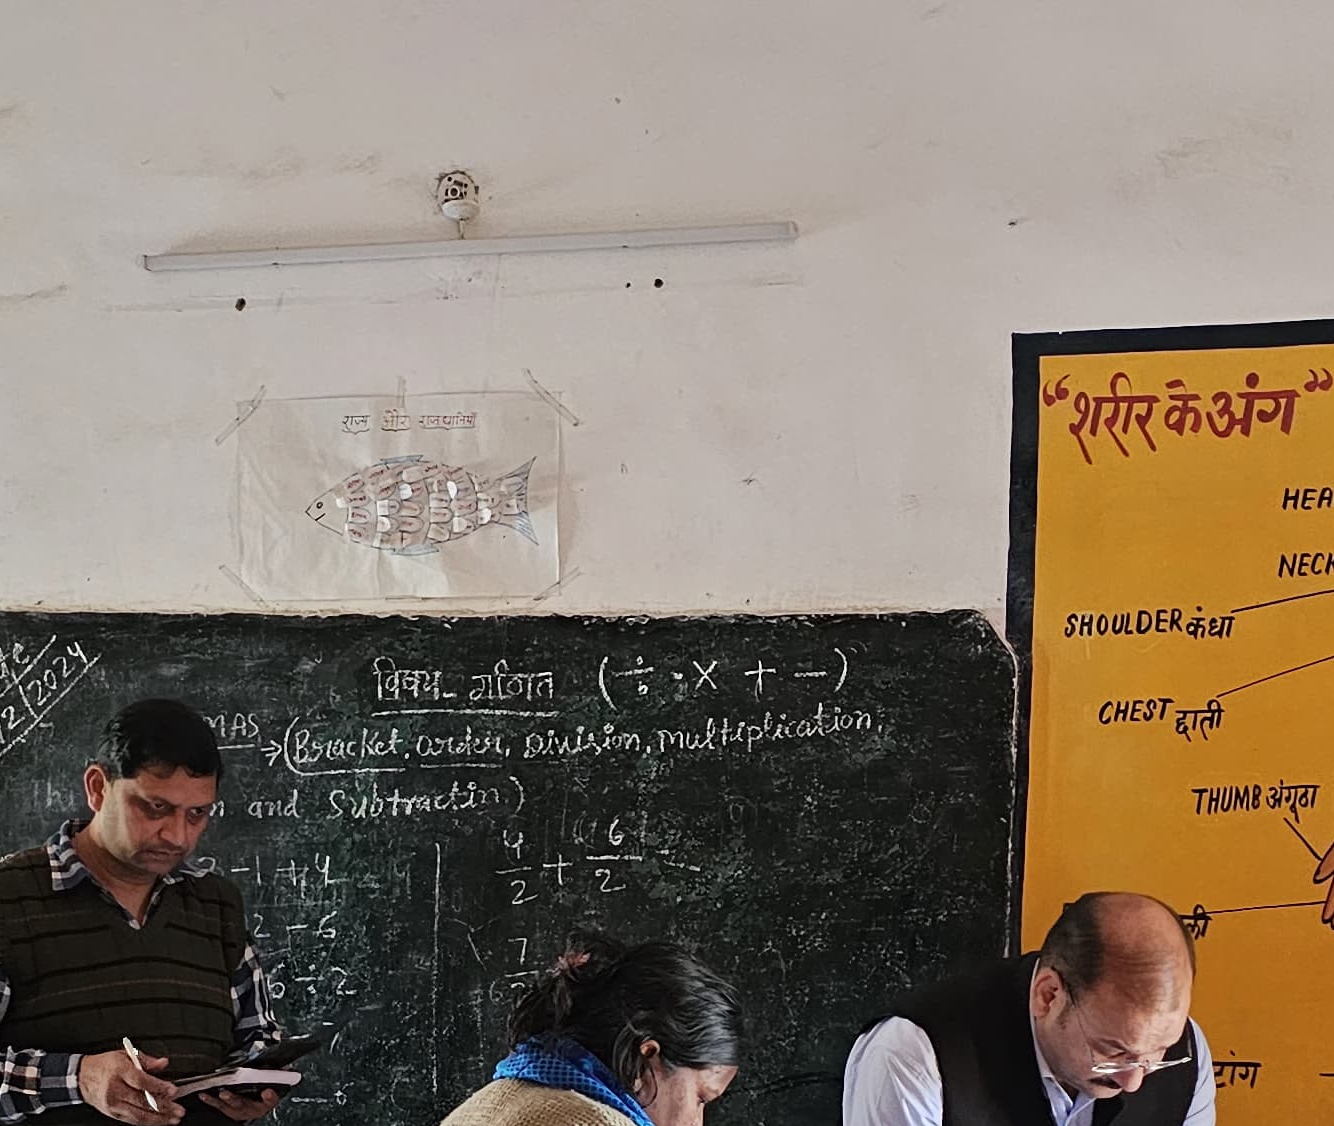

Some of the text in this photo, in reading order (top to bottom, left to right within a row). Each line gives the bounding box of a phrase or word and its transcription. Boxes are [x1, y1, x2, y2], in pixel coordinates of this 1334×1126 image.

[1064, 606, 1236, 640] SHOULDER कंधा
[1098, 698, 1174, 725] CHEST
[248, 788, 301, 819] and
[1191, 779, 1321, 824] THUMB अंगूठा
